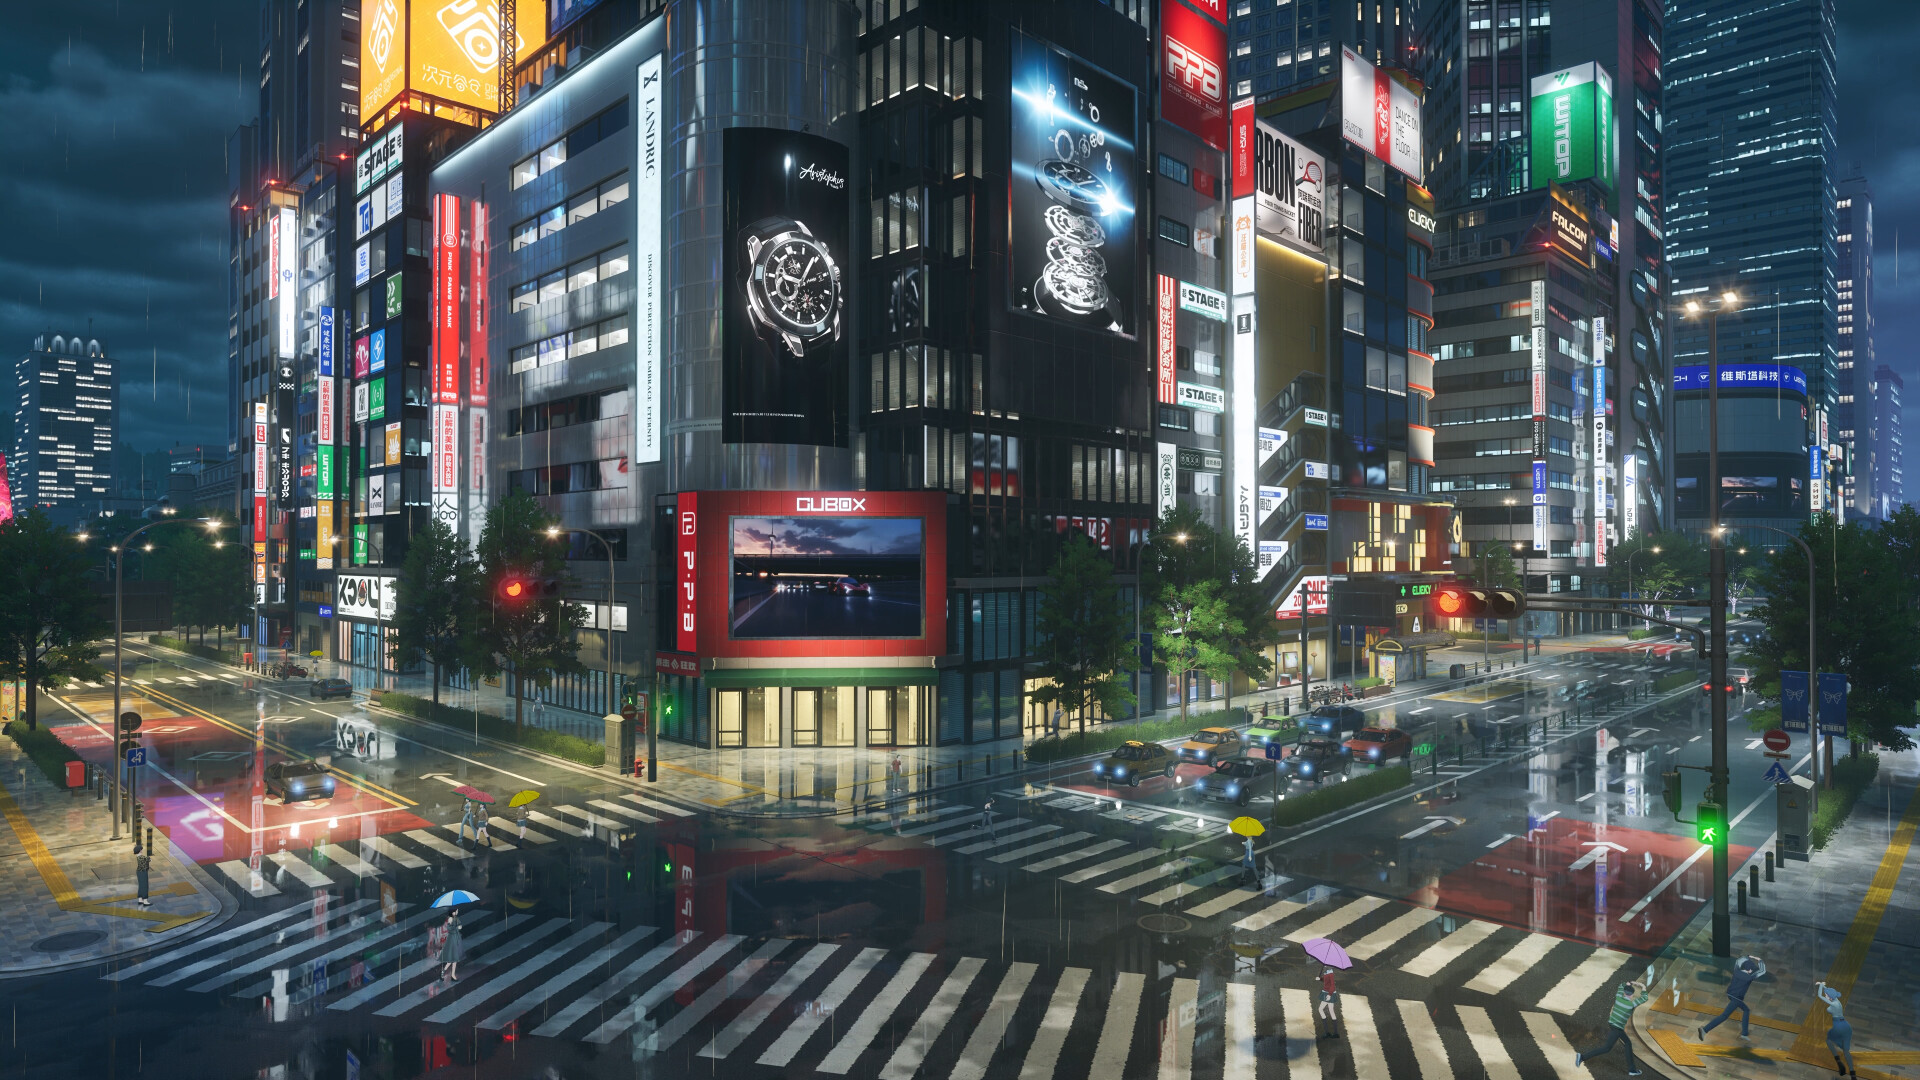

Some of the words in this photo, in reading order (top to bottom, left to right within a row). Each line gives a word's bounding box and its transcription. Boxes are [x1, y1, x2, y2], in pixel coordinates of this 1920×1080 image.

[646, 97, 655, 179] LANDRIC
[364, 137, 395, 176] STAGE
[1298, 202, 1322, 249] FIBER
[1552, 211, 1588, 244] FALCON
[1188, 289, 1220, 309] STAGE
[1721, 370, 1779, 382] 维斯塔科技
[1186, 388, 1218, 403] STAGE
[1307, 580, 1326, 606] SALE
